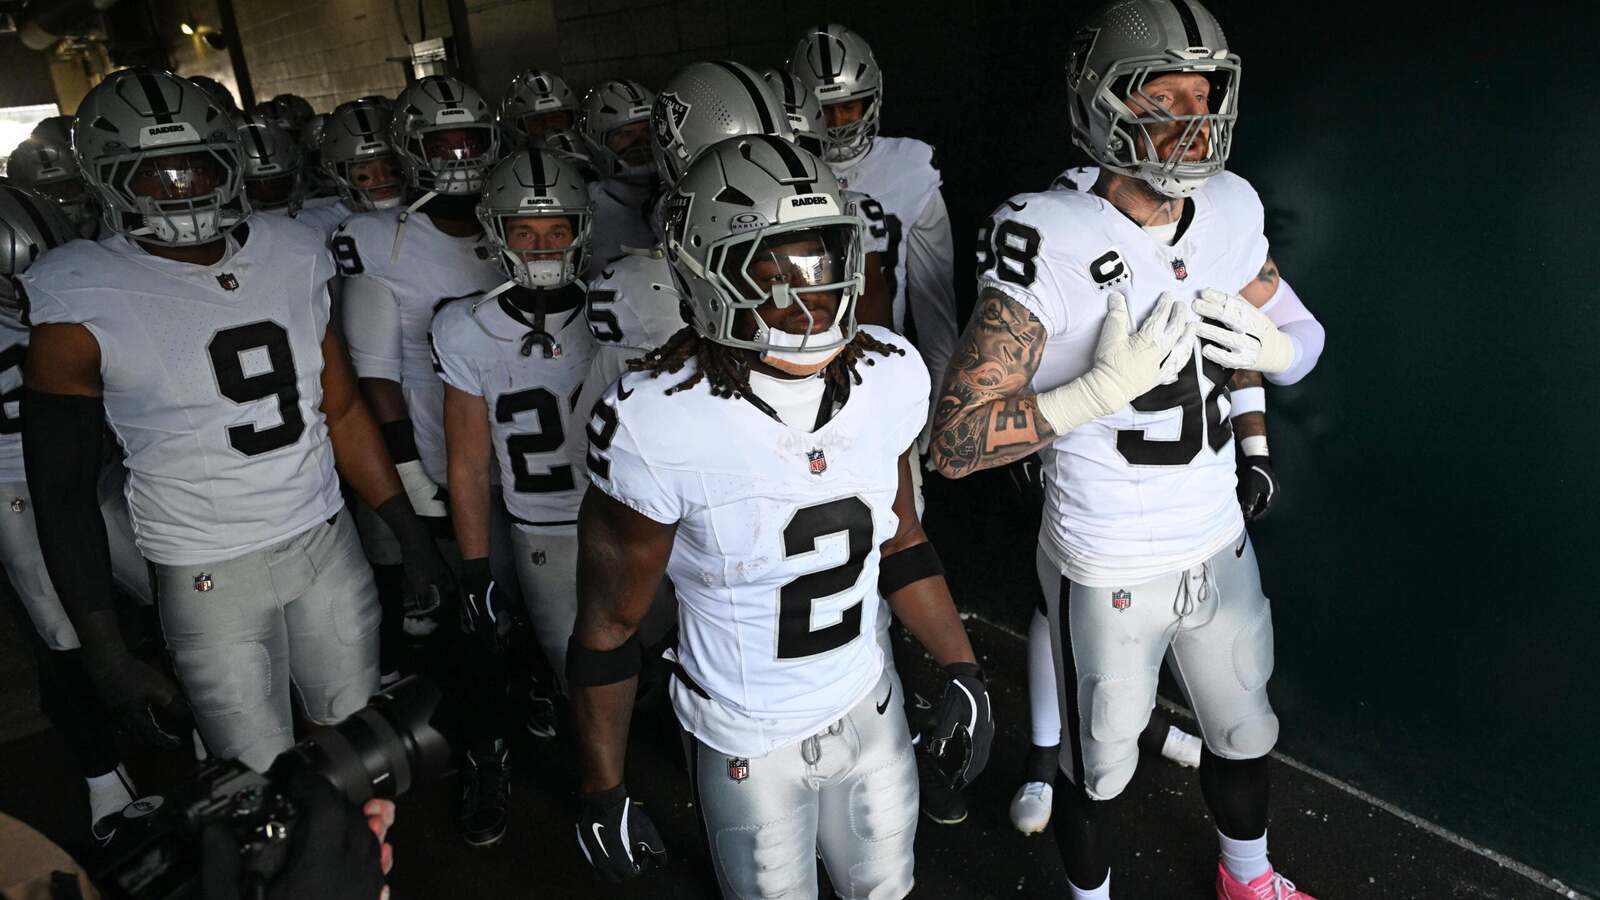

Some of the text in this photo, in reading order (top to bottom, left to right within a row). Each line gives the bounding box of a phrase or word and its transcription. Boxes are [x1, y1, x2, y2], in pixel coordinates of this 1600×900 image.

[149, 125, 184, 136] RAIDERS
[792, 197, 828, 207] RAIDERS
[860, 199, 888, 239] 9
[332, 236, 366, 275] 9
[1090, 250, 1124, 284] C
[586, 288, 624, 342] 5
[207, 320, 306, 456] 9
[586, 396, 619, 481] 2
[775, 494, 876, 662] 2
